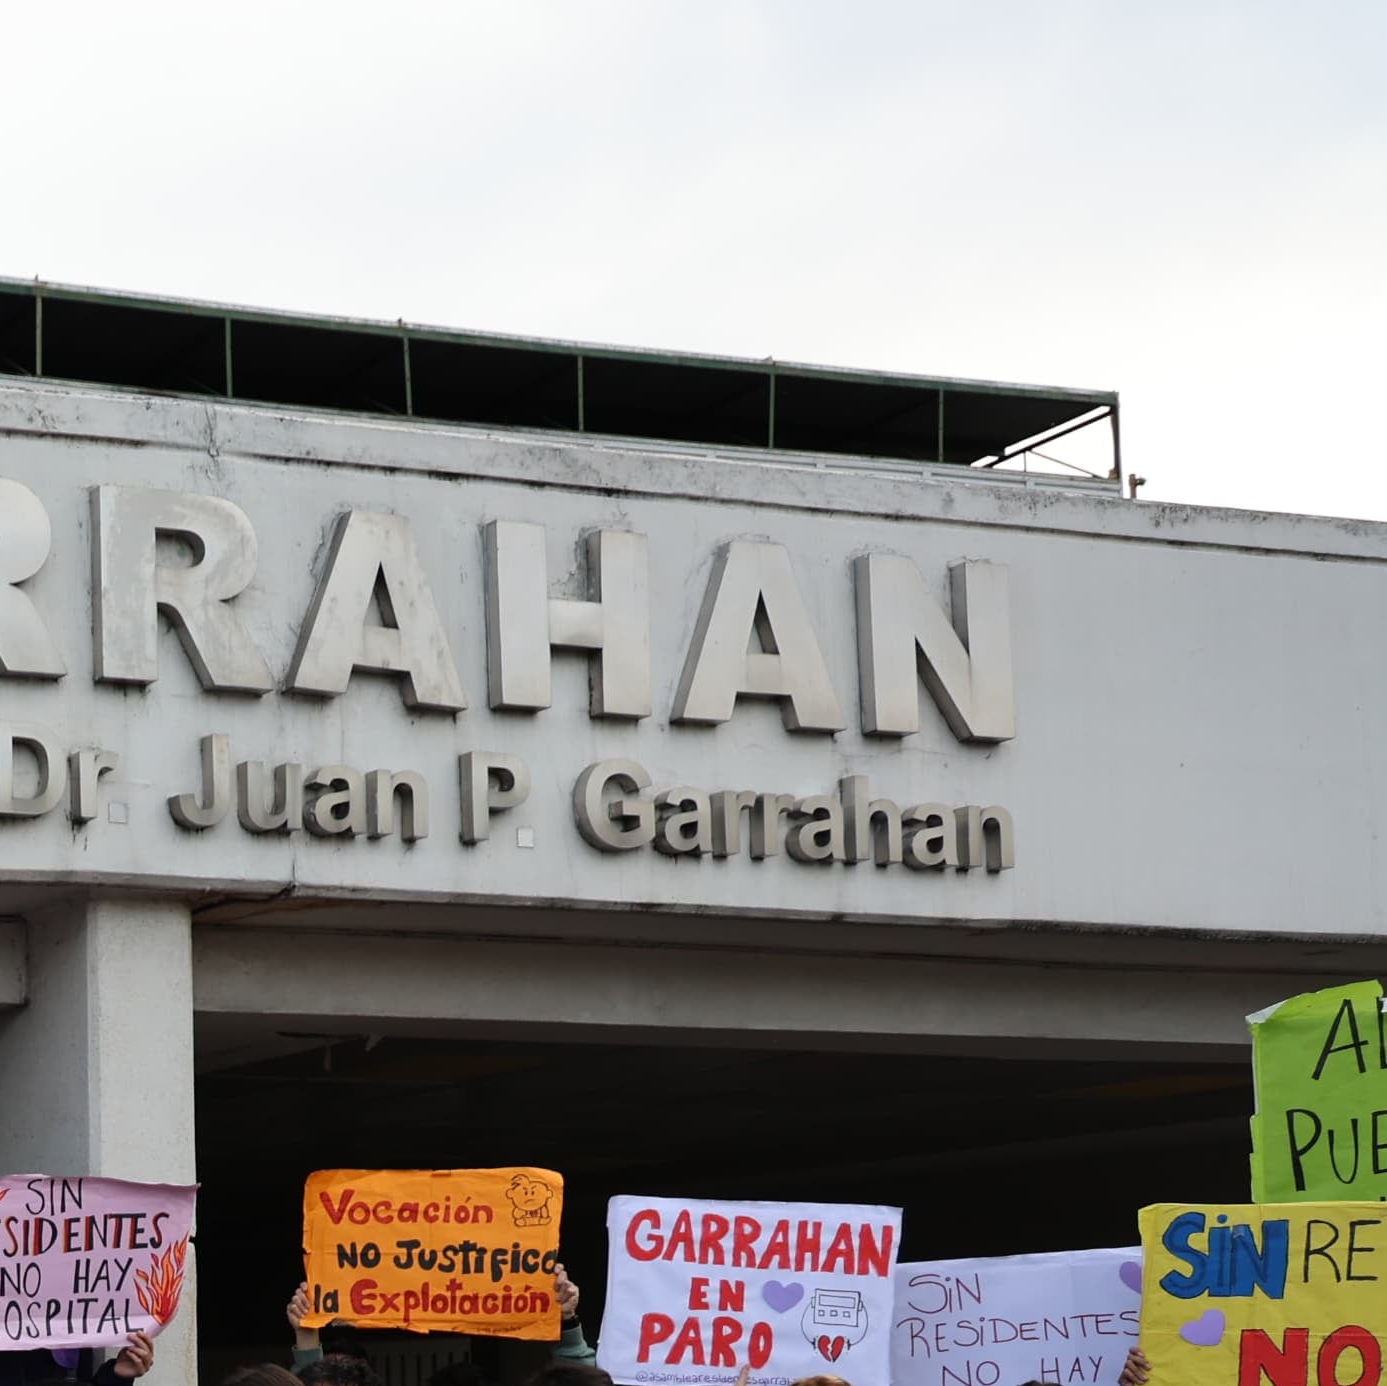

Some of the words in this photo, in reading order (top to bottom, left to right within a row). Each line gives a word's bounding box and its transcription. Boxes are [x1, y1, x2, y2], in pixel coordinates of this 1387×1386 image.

[167, 732, 429, 843] Juan
[458, 750, 535, 849] P.
[573, 756, 1016, 874] Garrahan
[25, 1178, 82, 1215] SIN
[319, 1188, 494, 1226] Vocación
[336, 1241, 382, 1270] NO
[625, 1208, 894, 1278] GARRAHAN
[0, 1261, 43, 1300] NO
[73, 1257, 135, 1295] HAY
[688, 1276, 745, 1313] EN
[313, 1283, 340, 1314] la
[349, 1277, 551, 1323] Explotación
[636, 1312, 774, 1370] PARO
[1040, 1355, 1104, 1384] HAY
